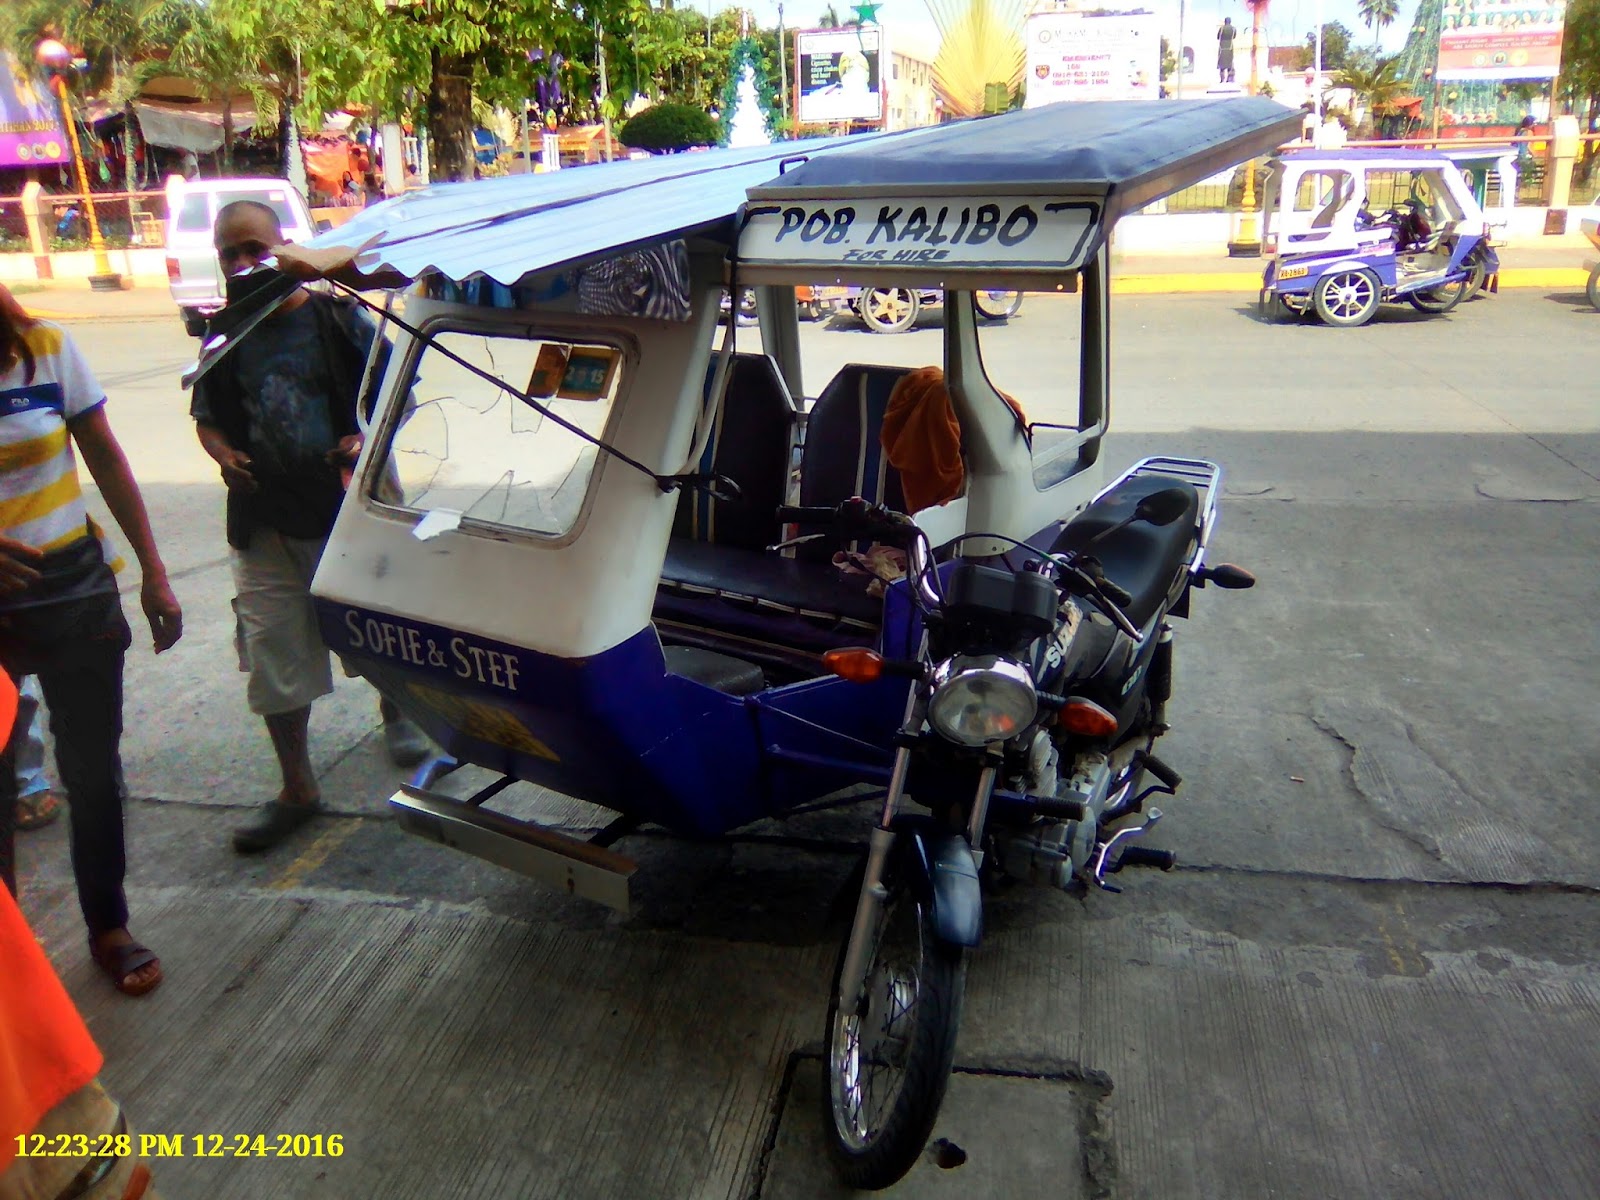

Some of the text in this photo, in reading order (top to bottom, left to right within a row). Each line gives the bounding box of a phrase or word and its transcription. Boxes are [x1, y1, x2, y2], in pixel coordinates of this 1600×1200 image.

[775, 204, 1039, 247] POB. KALIBO
[841, 248, 951, 262] FOR HIRE
[345, 610, 520, 691] SOFIE & STEF
